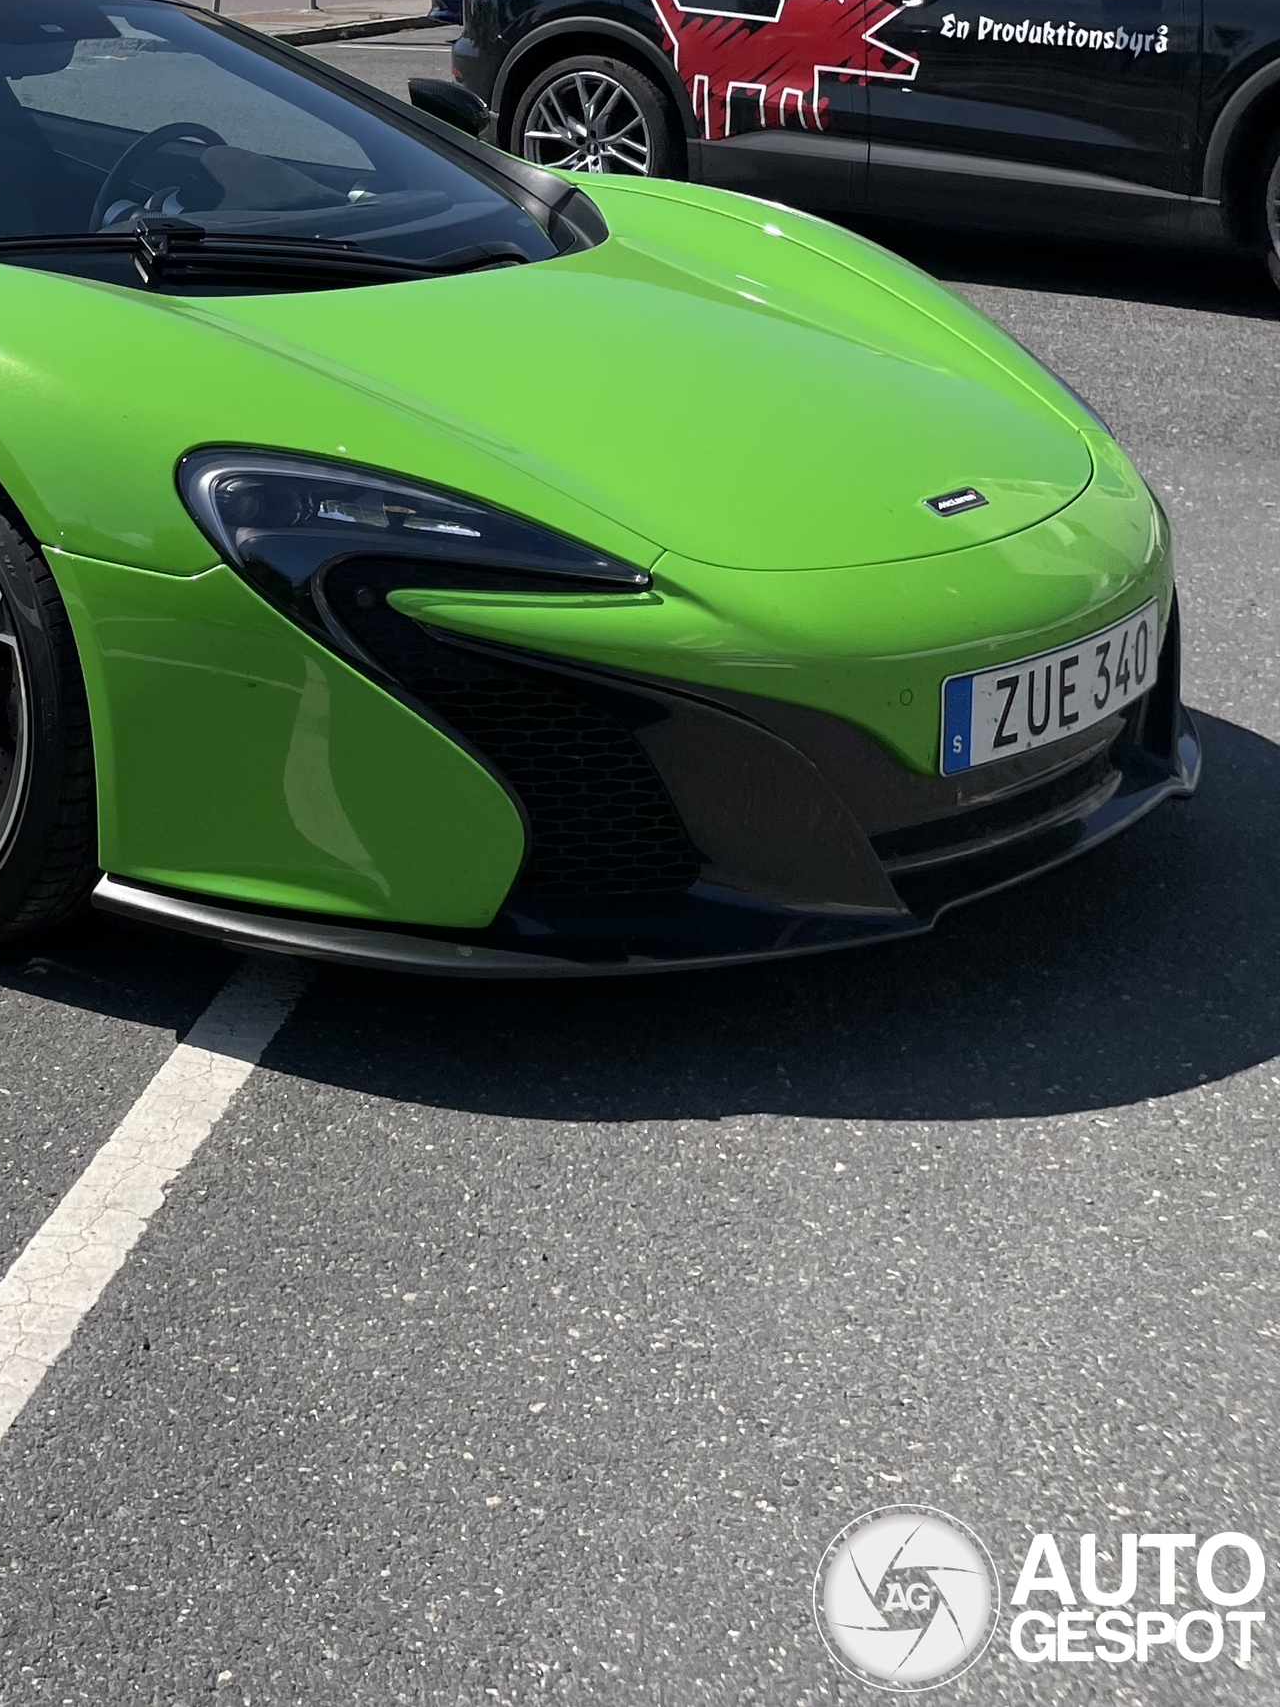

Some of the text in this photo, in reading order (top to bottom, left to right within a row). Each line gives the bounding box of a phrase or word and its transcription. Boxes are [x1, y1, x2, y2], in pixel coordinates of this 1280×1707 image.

[940, 13, 1169, 58] En Produktionsbyrå
[952, 620, 1148, 754] S ZUE 340
